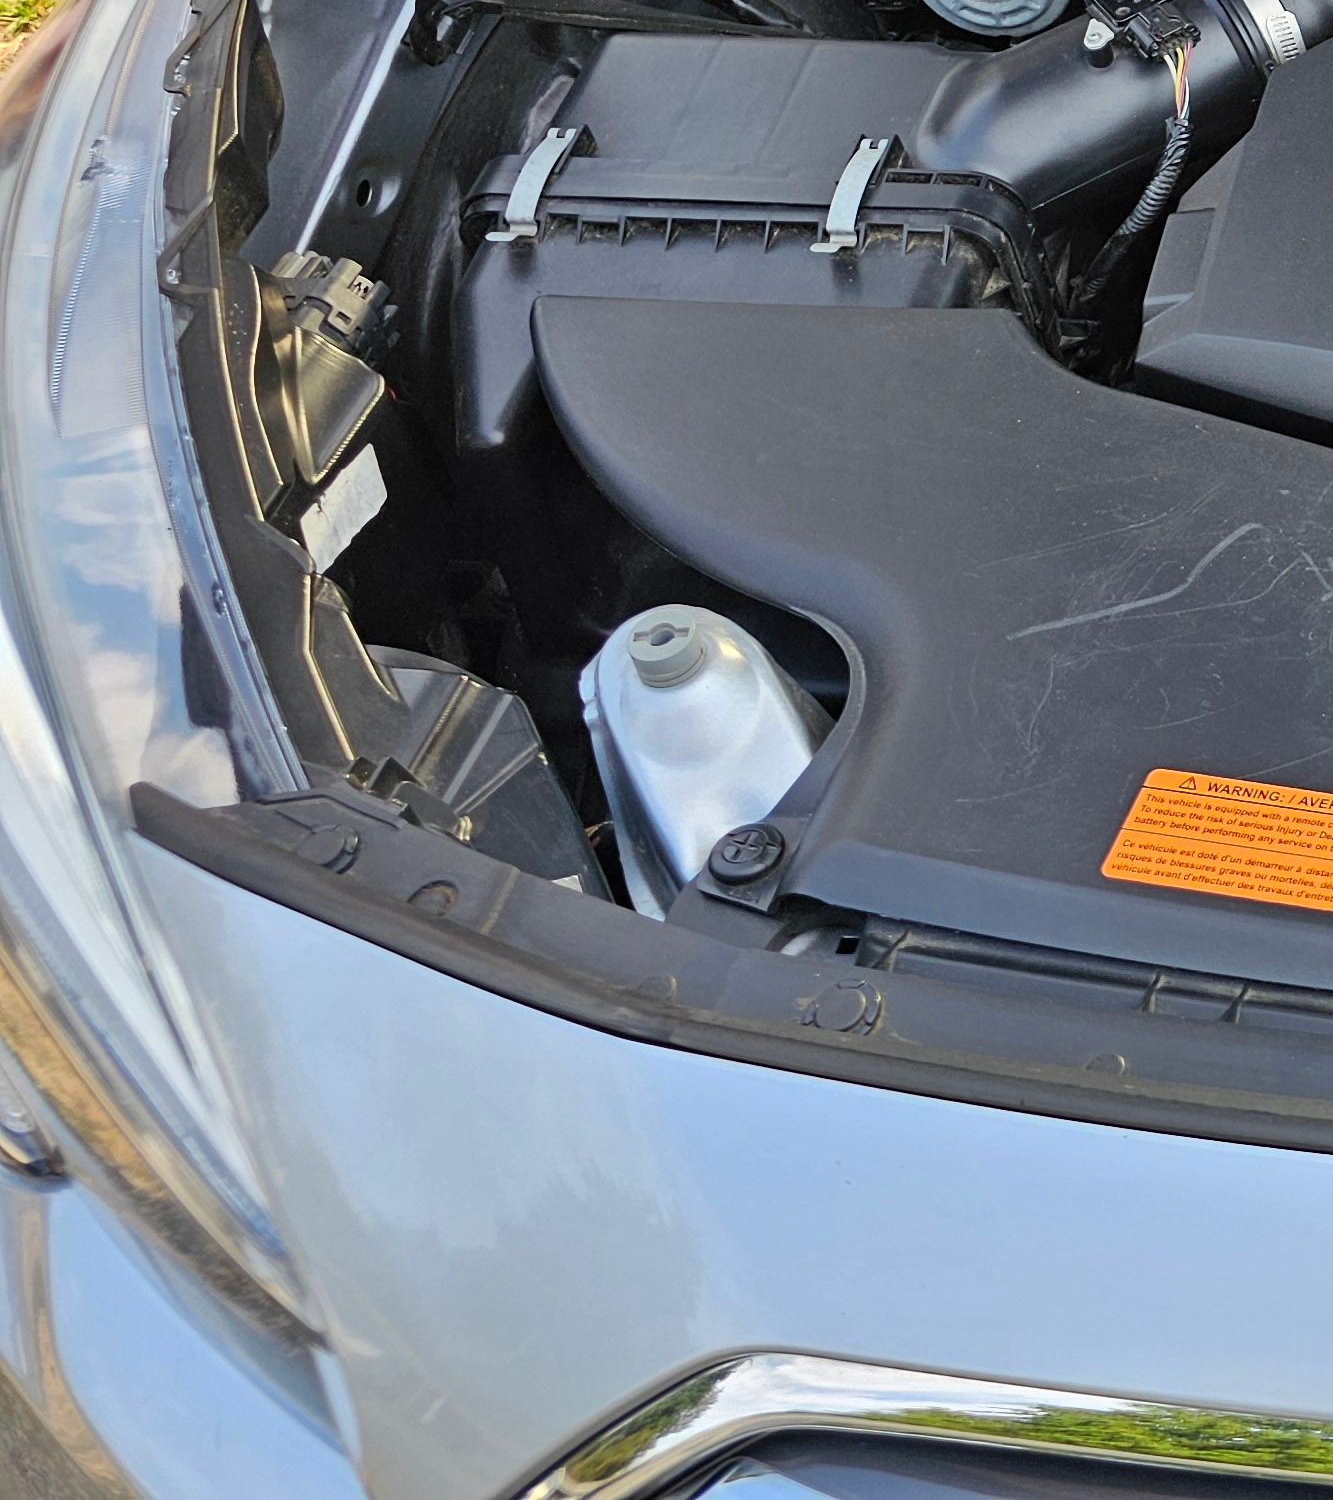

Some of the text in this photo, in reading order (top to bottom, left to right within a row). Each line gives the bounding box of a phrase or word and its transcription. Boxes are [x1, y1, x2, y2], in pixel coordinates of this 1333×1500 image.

[1207, 783, 1285, 802] WARNING:
[1146, 794, 1165, 802] This
[1168, 798, 1201, 808] vehicle
[1215, 805, 1259, 817] equipped
[1293, 817, 1325, 826] remote
[1154, 807, 1186, 817] reduce
[1207, 815, 1224, 823] risk
[1239, 821, 1274, 830] serious
[1134, 816, 1167, 827] battery
[1170, 822, 1200, 831] before
[1202, 827, 1255, 840] performing
[1278, 838, 1312, 848] service
[1117, 852, 1152, 863] risques
[1170, 860, 1217, 872] blessures
[1219, 868, 1251, 878] graves
[1154, 869, 1181, 878] avant
[1237, 882, 1255, 890] des
[1257, 885, 1293, 896] travaux
